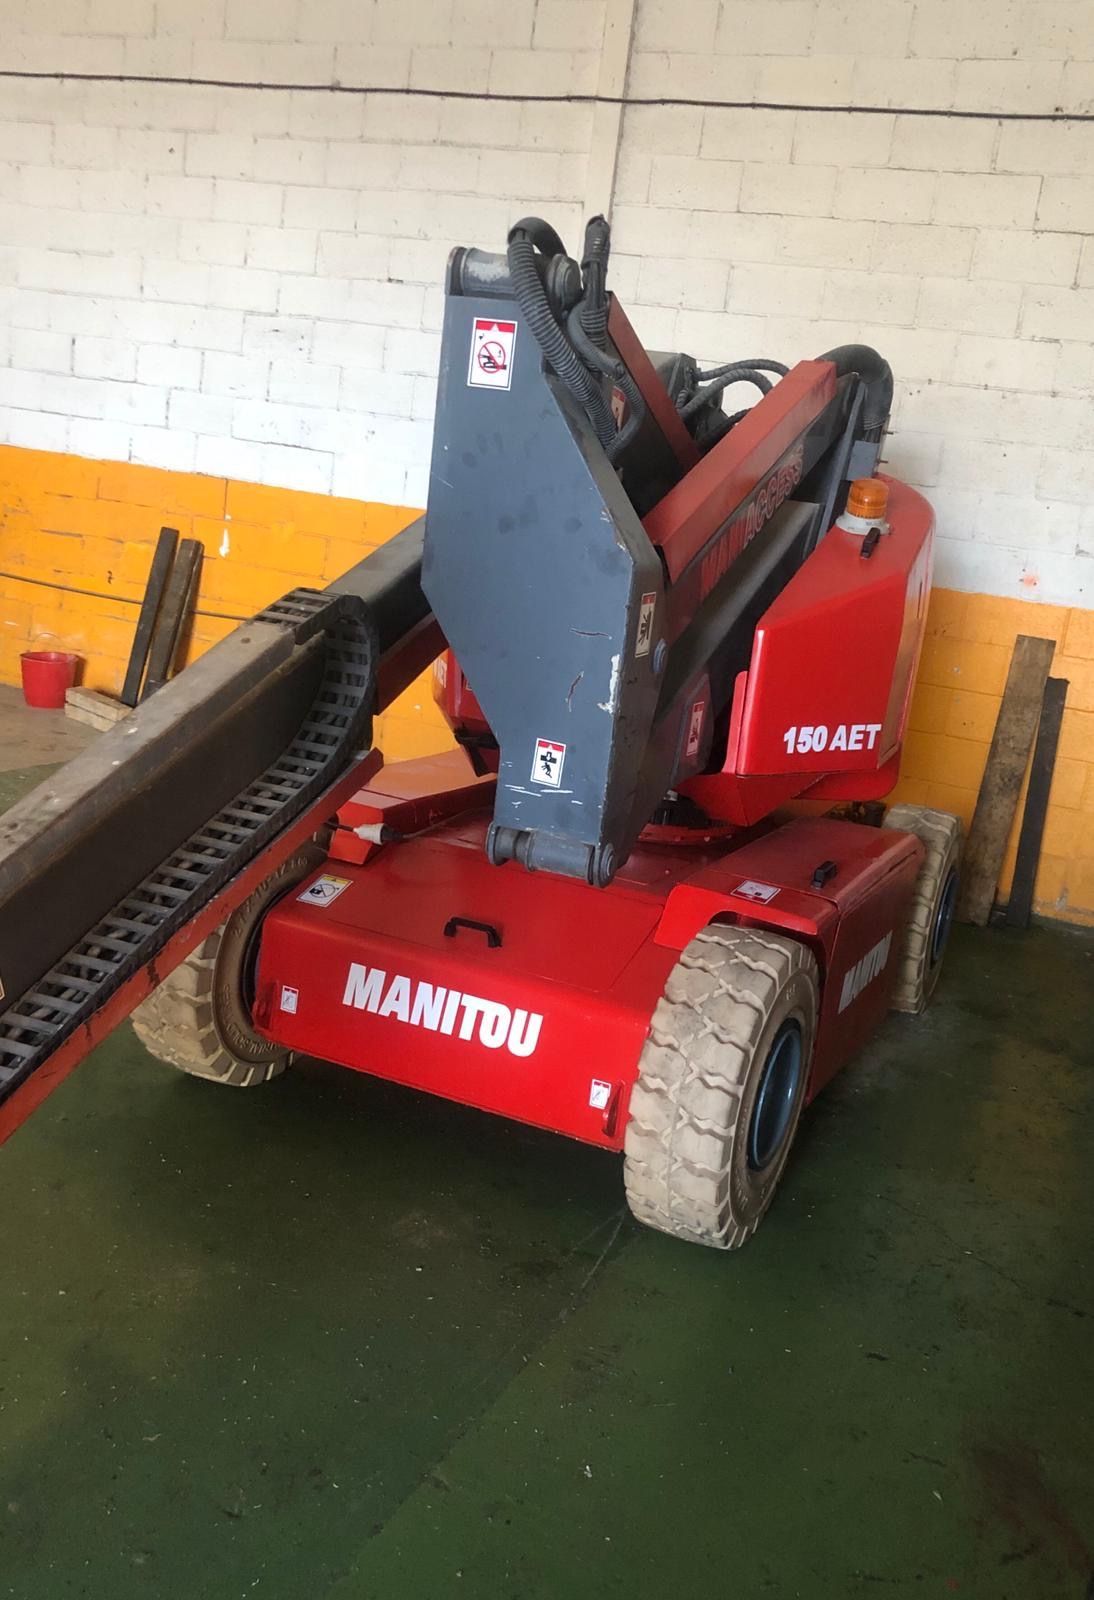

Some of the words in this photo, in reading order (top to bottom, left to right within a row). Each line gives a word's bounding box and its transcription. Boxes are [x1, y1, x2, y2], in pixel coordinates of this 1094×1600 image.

[783, 725, 829, 754] 150
[828, 723, 882, 751] AET
[342, 962, 544, 1057] MANITOU
